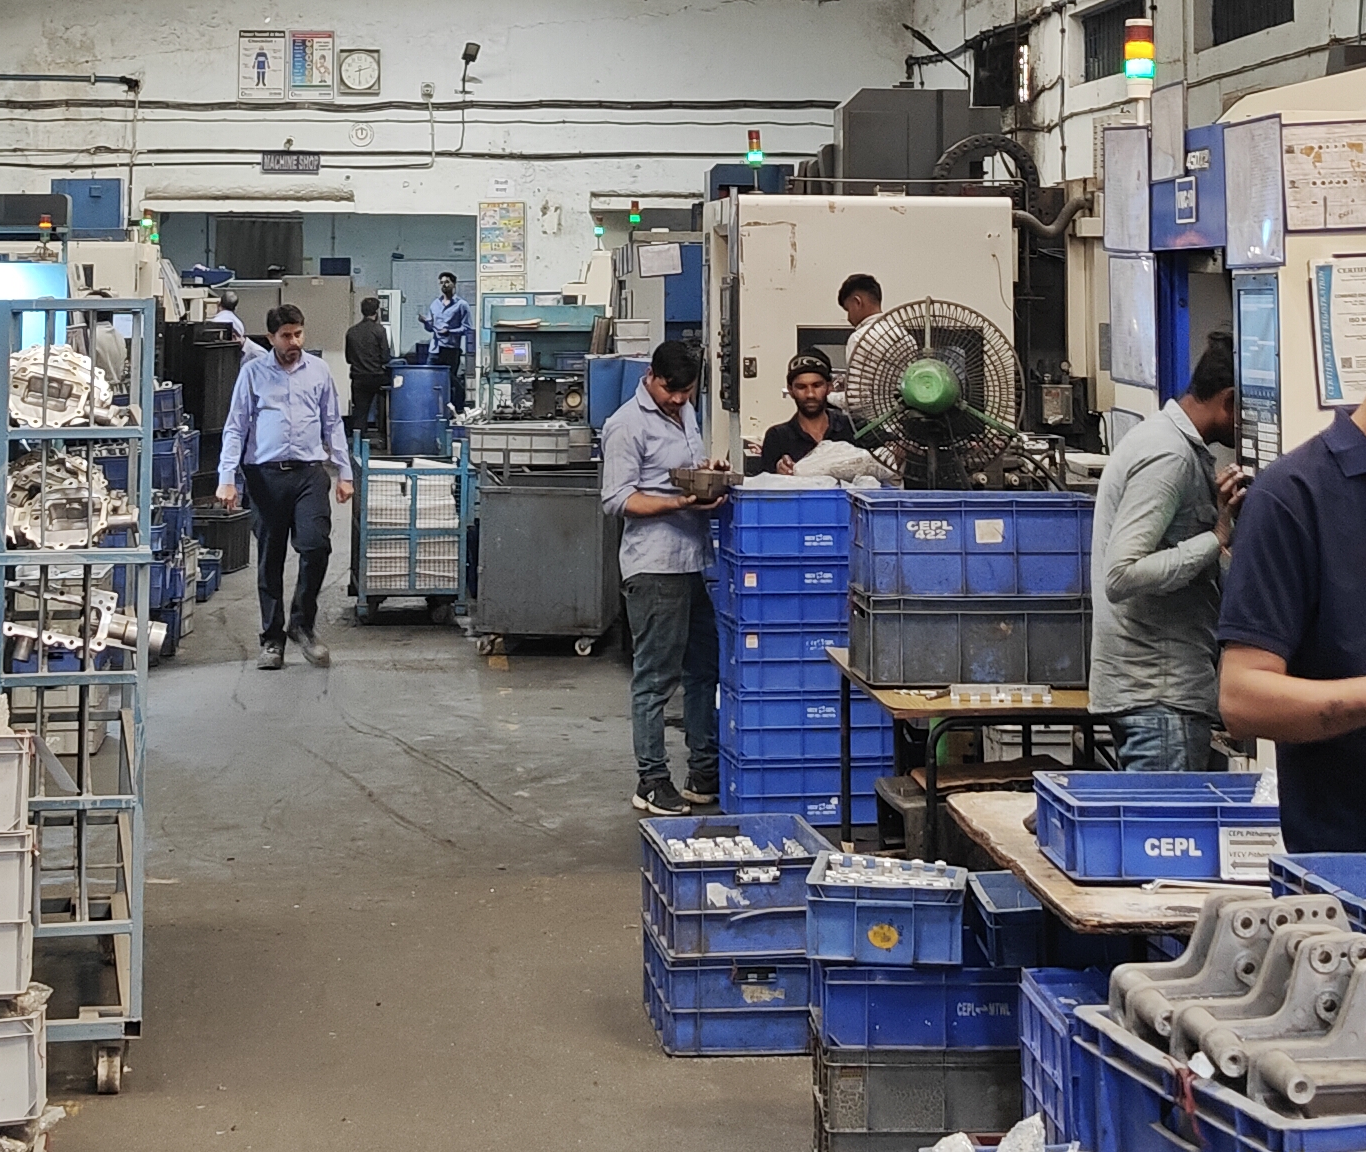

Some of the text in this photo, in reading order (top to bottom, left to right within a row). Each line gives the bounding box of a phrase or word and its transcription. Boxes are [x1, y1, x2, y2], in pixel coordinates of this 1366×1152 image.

[263, 154, 319, 170] MACHINE SHOP
[906, 520, 953, 531] CEPL
[915, 529, 947, 540] 422
[1144, 837, 1203, 857] CEPL
[957, 1002, 977, 1016] CEPL
